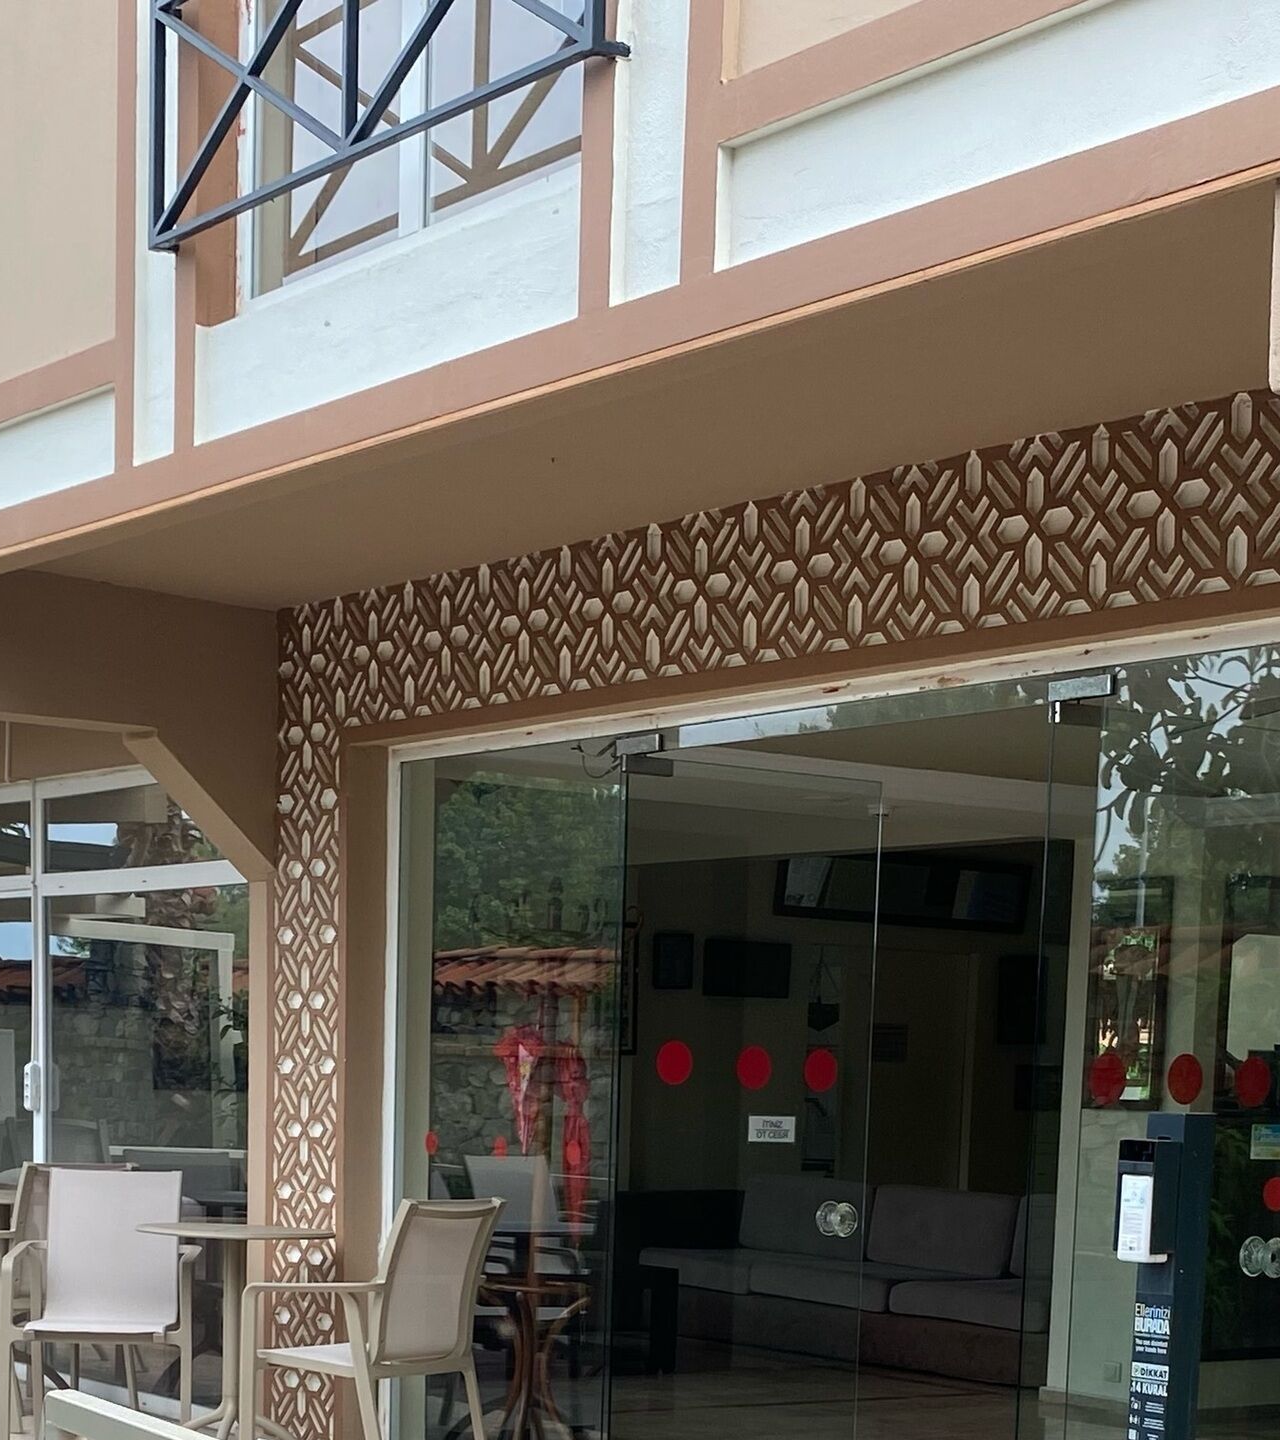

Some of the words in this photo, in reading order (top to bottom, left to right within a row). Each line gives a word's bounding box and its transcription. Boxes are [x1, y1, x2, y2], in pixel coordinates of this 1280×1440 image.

[1135, 1303, 1171, 1319] Ellerinizi
[1134, 1317, 1170, 1335] BURADA
[1140, 1365, 1168, 1379] DİKKAT
[1142, 1382, 1168, 1397] KURAL
